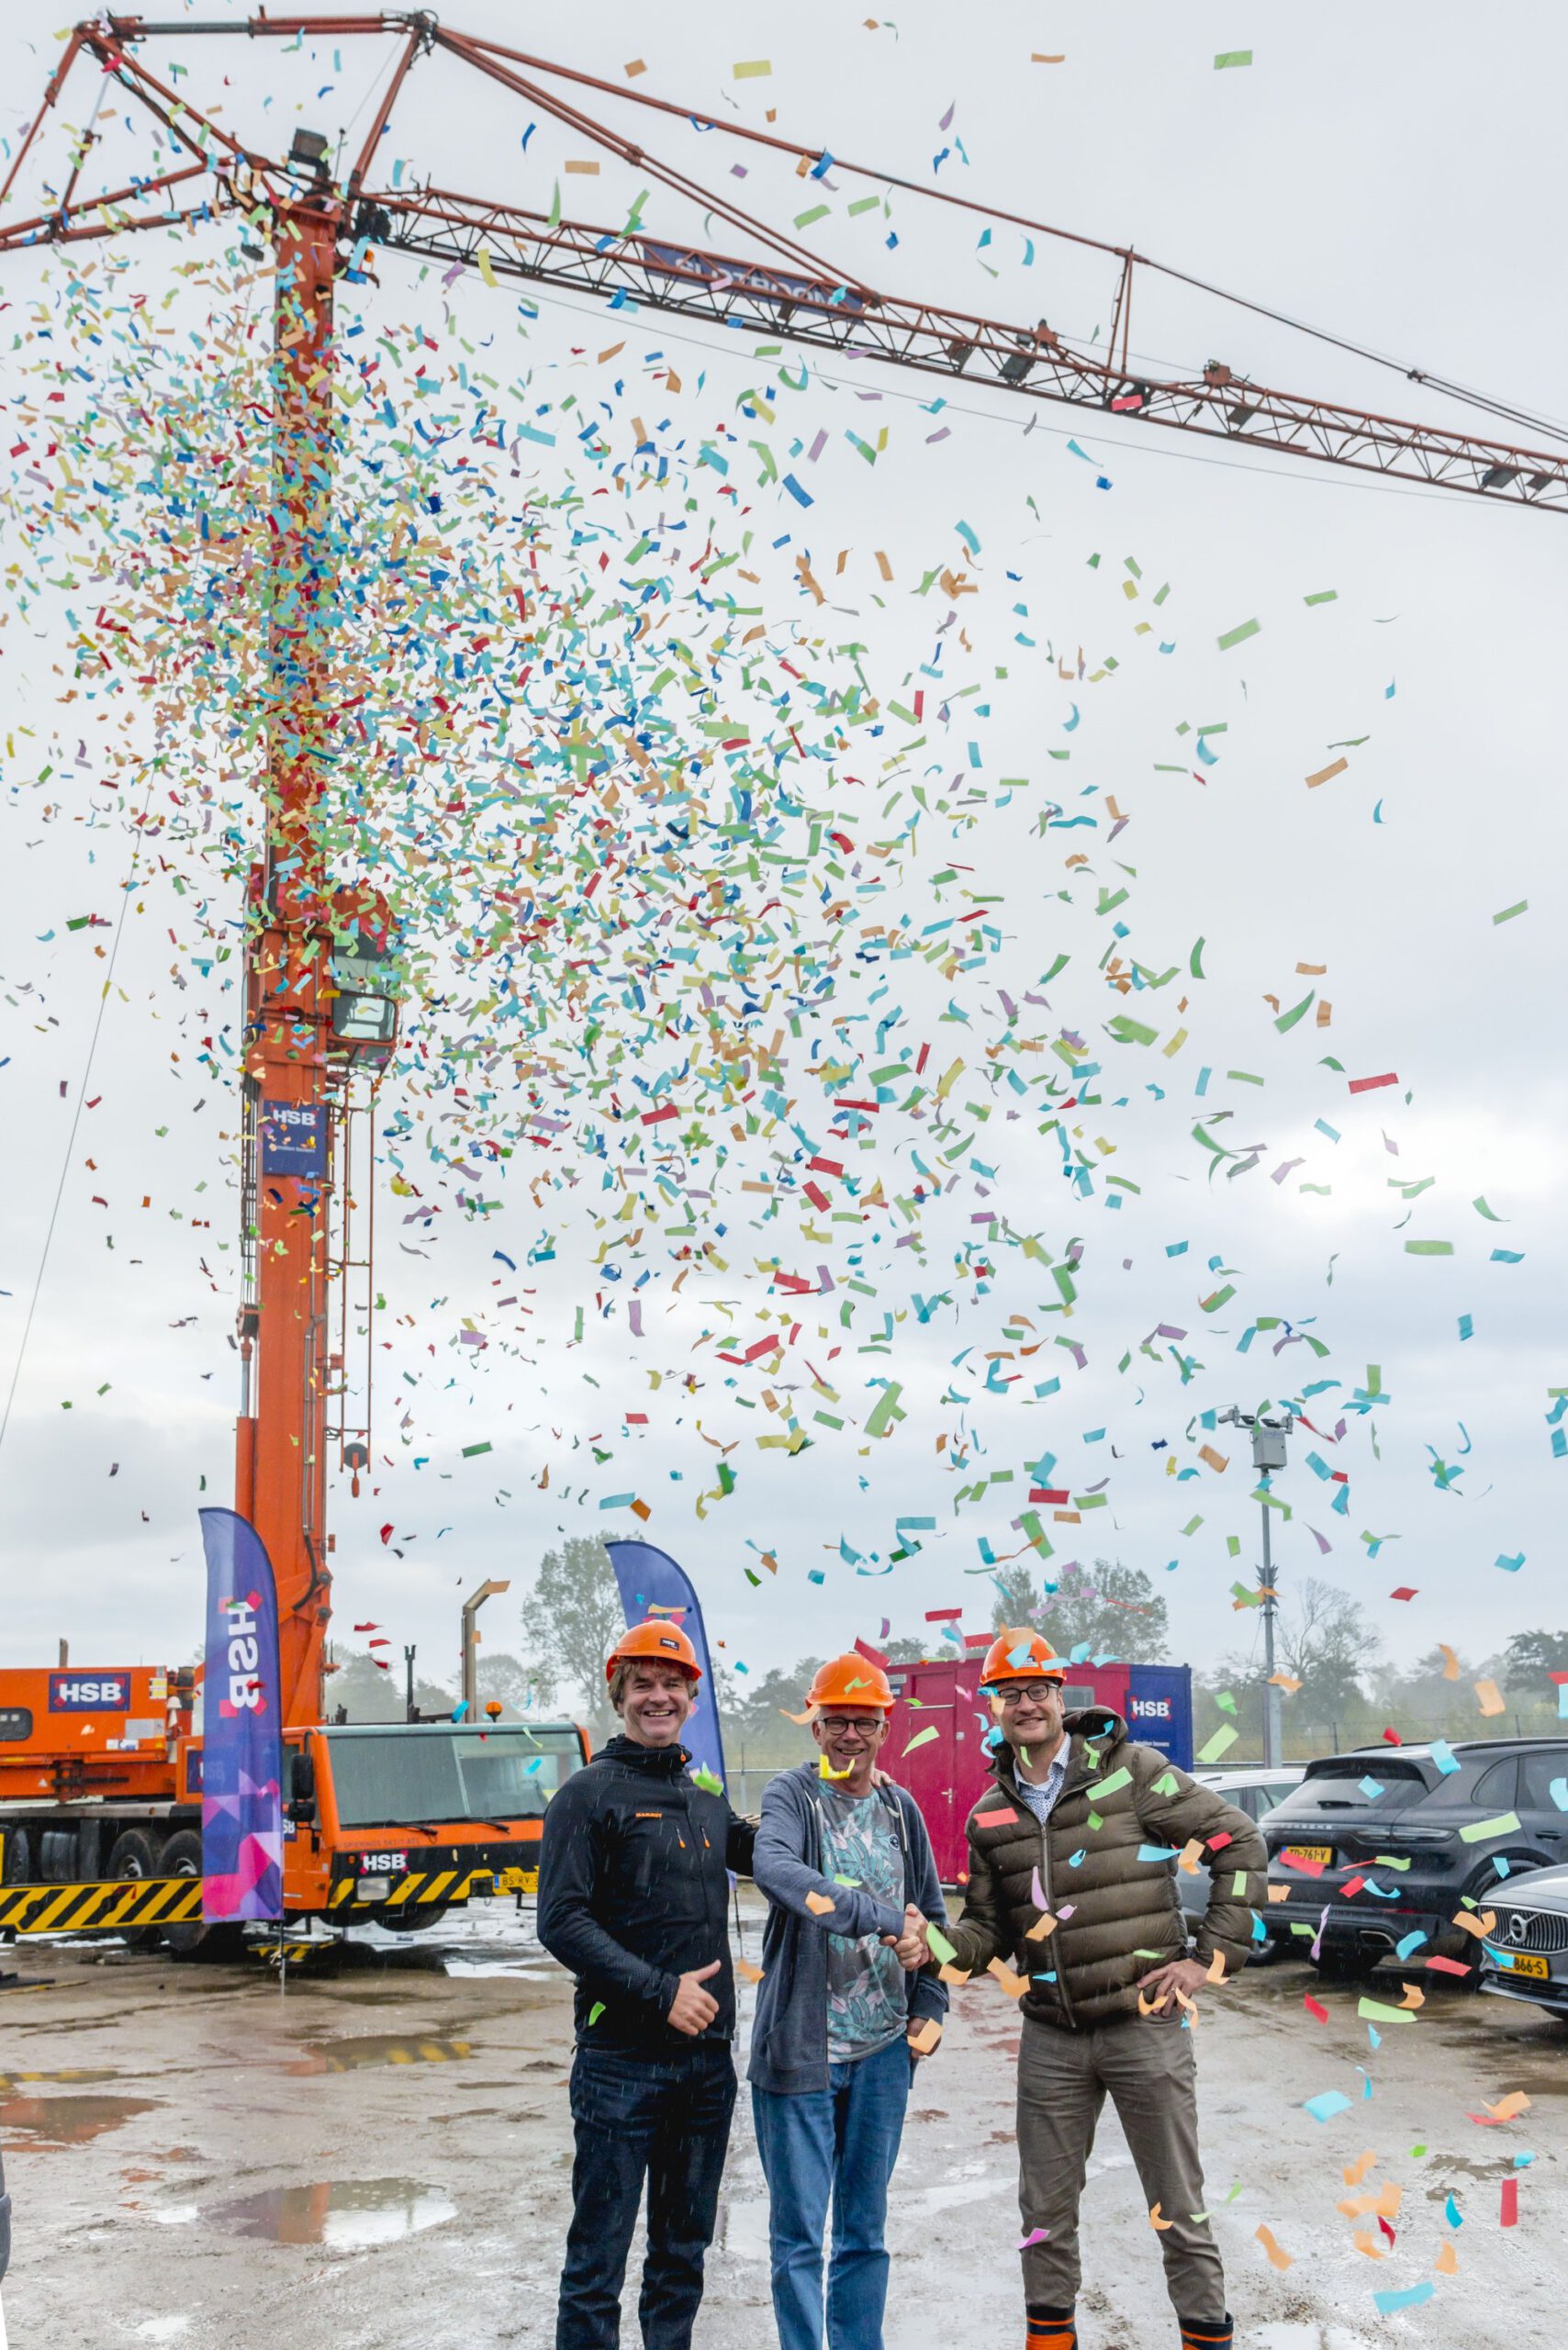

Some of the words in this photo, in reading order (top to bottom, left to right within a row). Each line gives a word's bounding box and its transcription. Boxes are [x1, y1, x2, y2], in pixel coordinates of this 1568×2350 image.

[273, 1109, 316, 1125] HSB
[59, 1683, 121, 1702] HSB
[1132, 1700, 1170, 1717] HSB
[283, 1818, 296, 1834] SB
[363, 1853, 407, 1871] HSB
